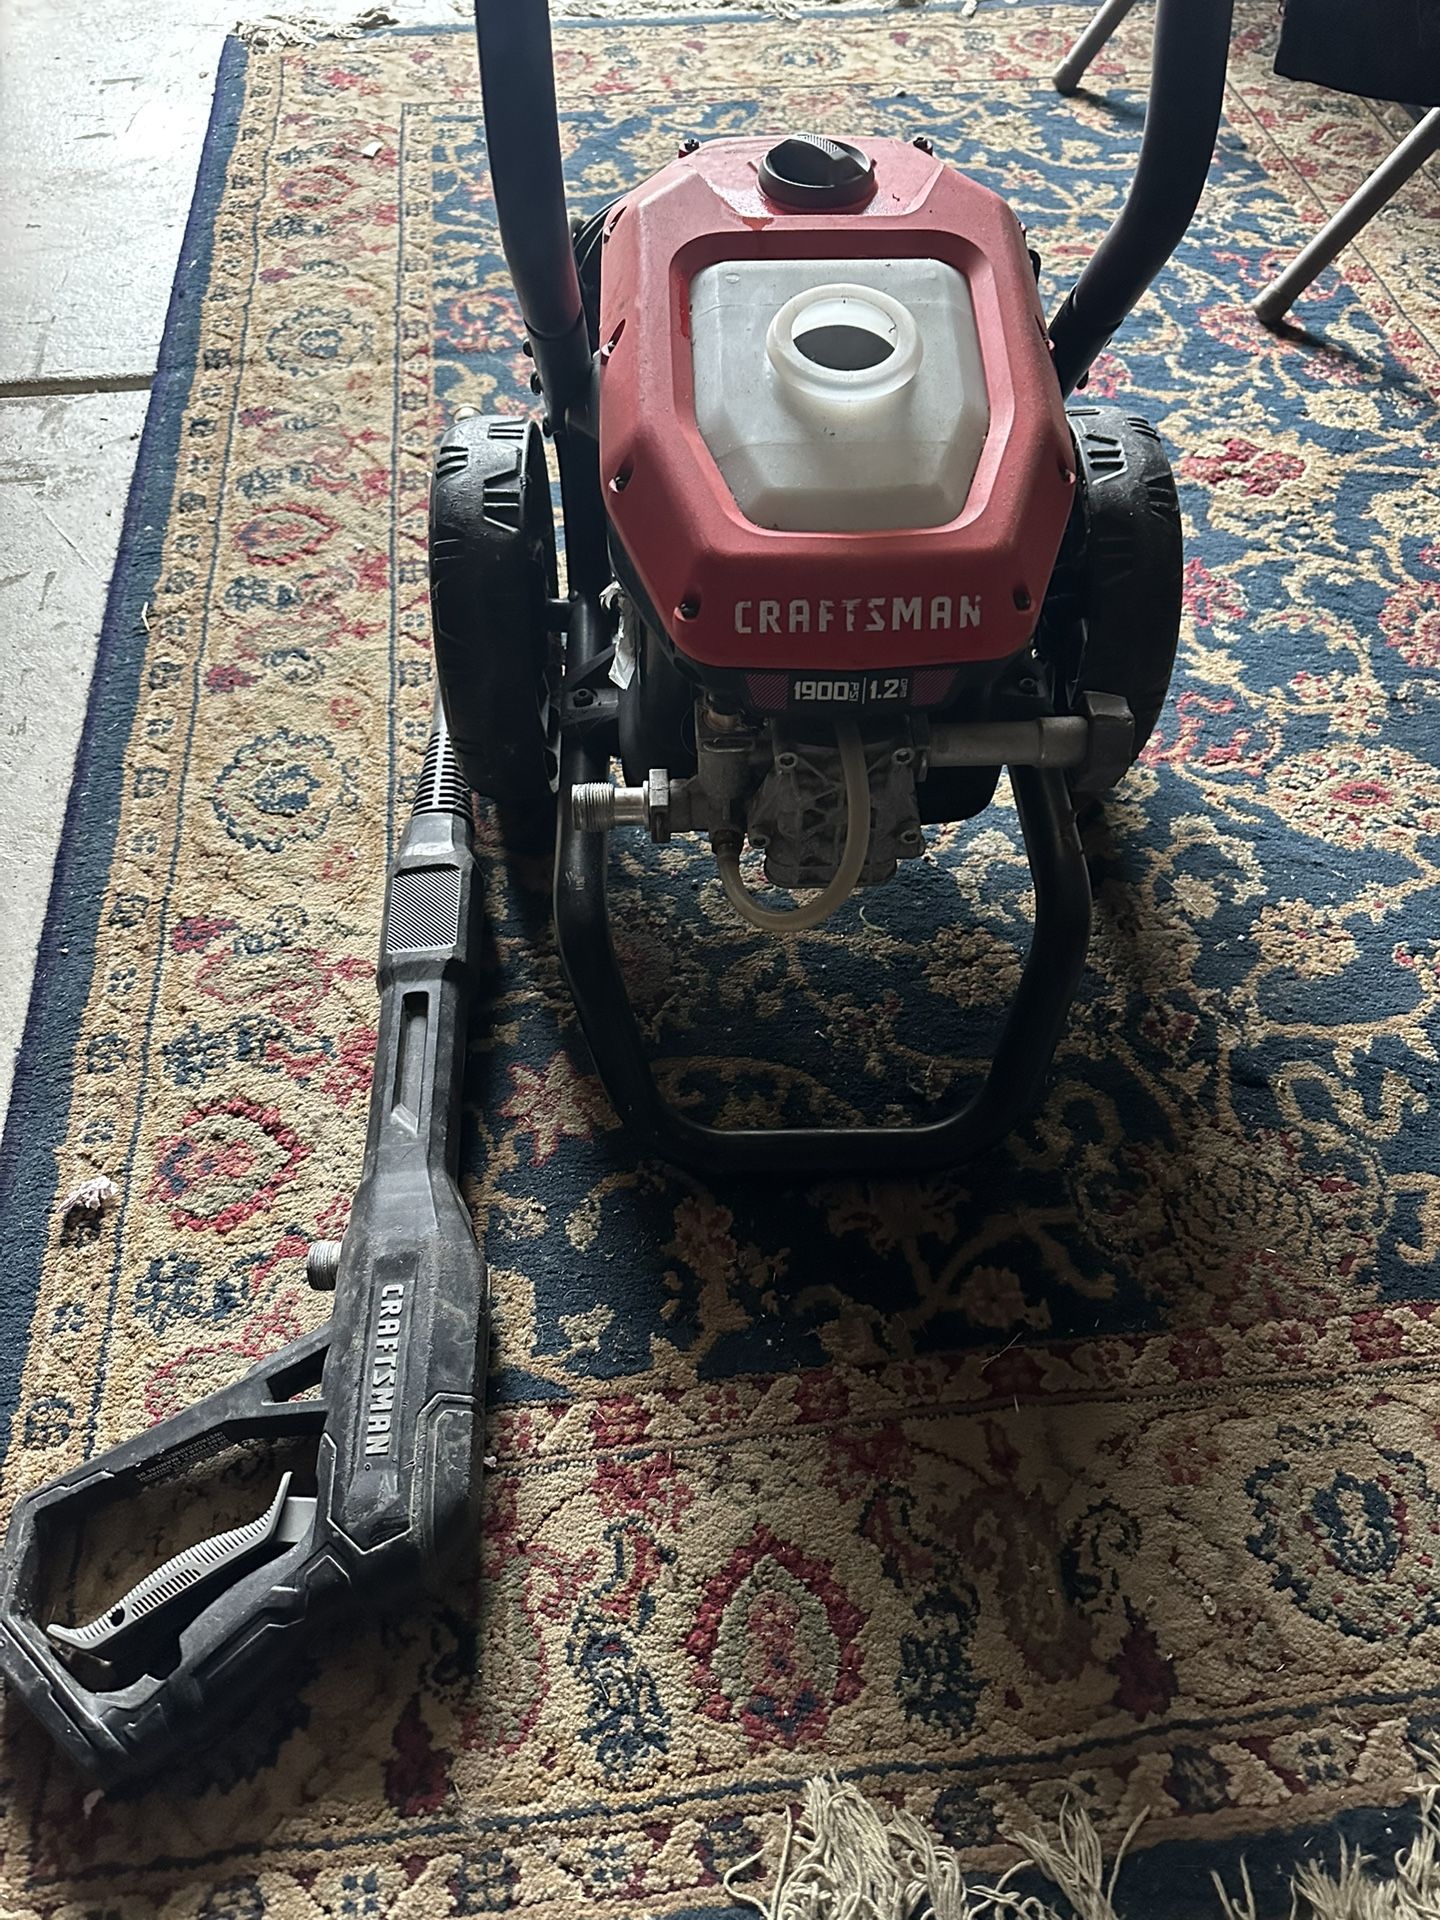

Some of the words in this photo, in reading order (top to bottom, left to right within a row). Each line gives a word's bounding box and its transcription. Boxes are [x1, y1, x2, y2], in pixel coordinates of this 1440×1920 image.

[734, 594, 983, 634] CRAFTSMAN
[793, 680, 850, 701] 1900
[849, 681, 861, 702] PSI
[870, 678, 900, 699] 1.2
[365, 1283, 404, 1456] CRAFTSMAN
